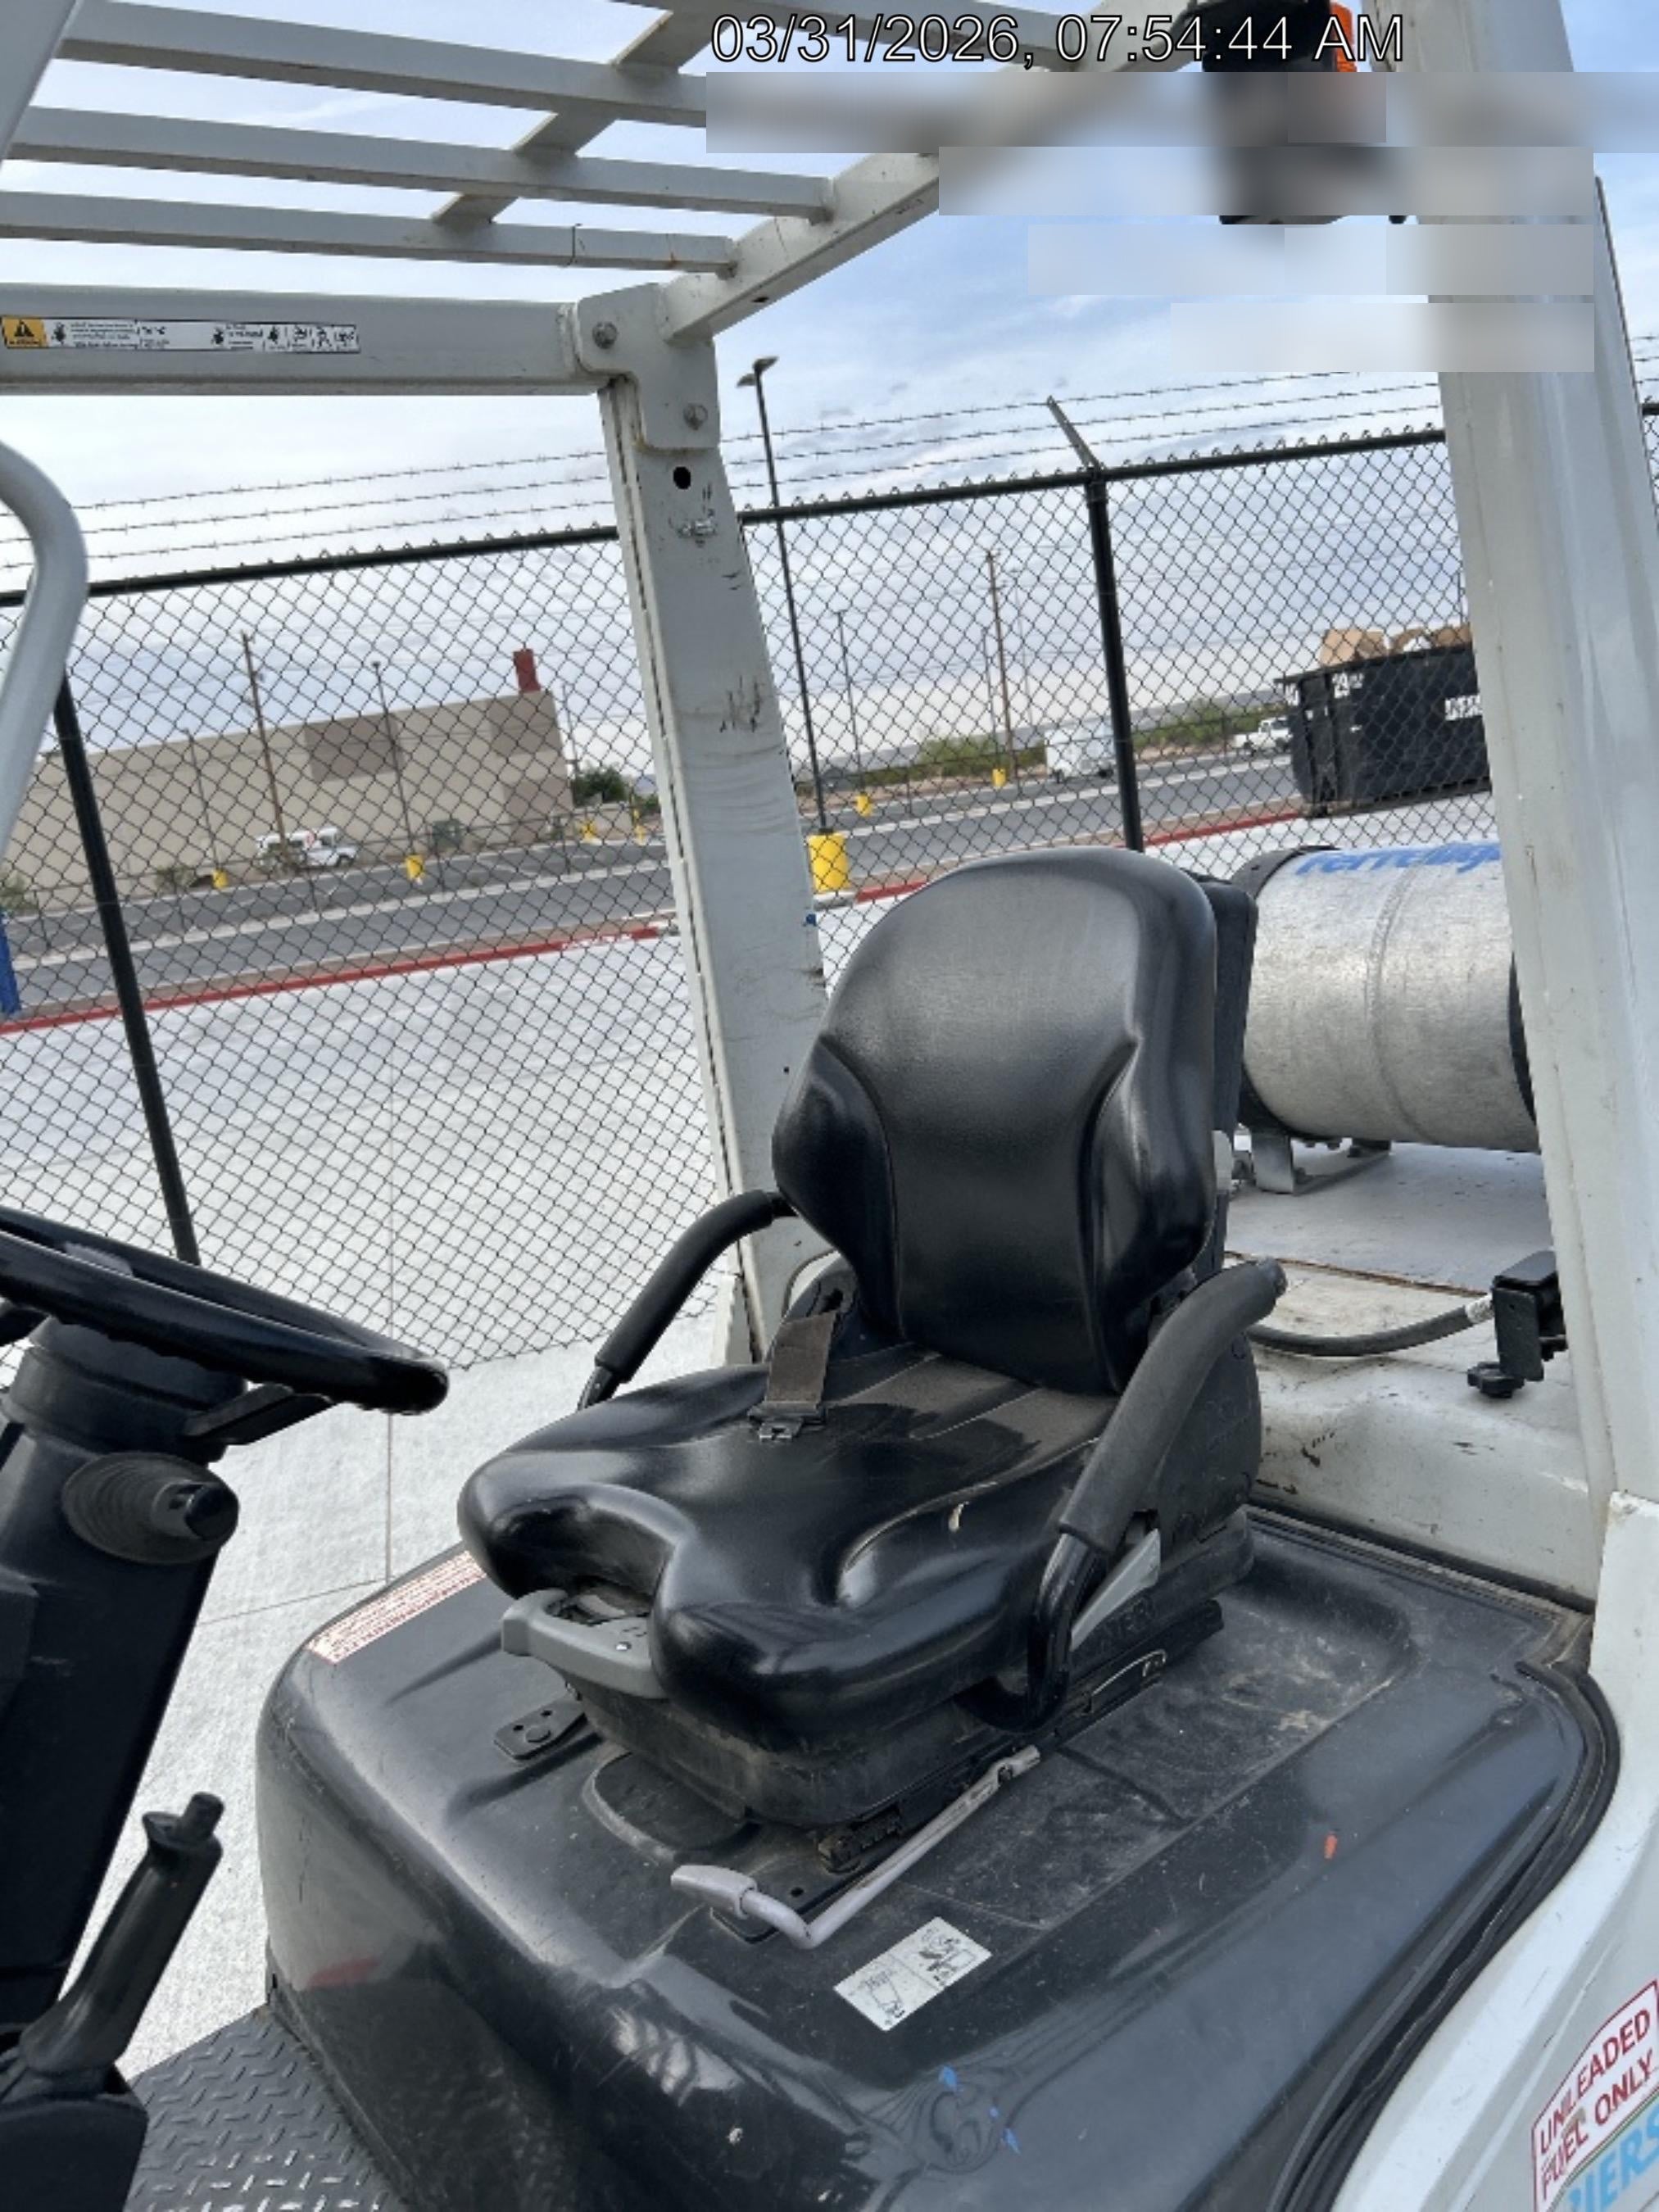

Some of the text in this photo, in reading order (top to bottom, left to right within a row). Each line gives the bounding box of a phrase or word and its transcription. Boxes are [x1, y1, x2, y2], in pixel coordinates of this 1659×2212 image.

[1540, 2009, 1651, 2155] UNLEADED
[1541, 2048, 1652, 2201] FUEL ONLY
